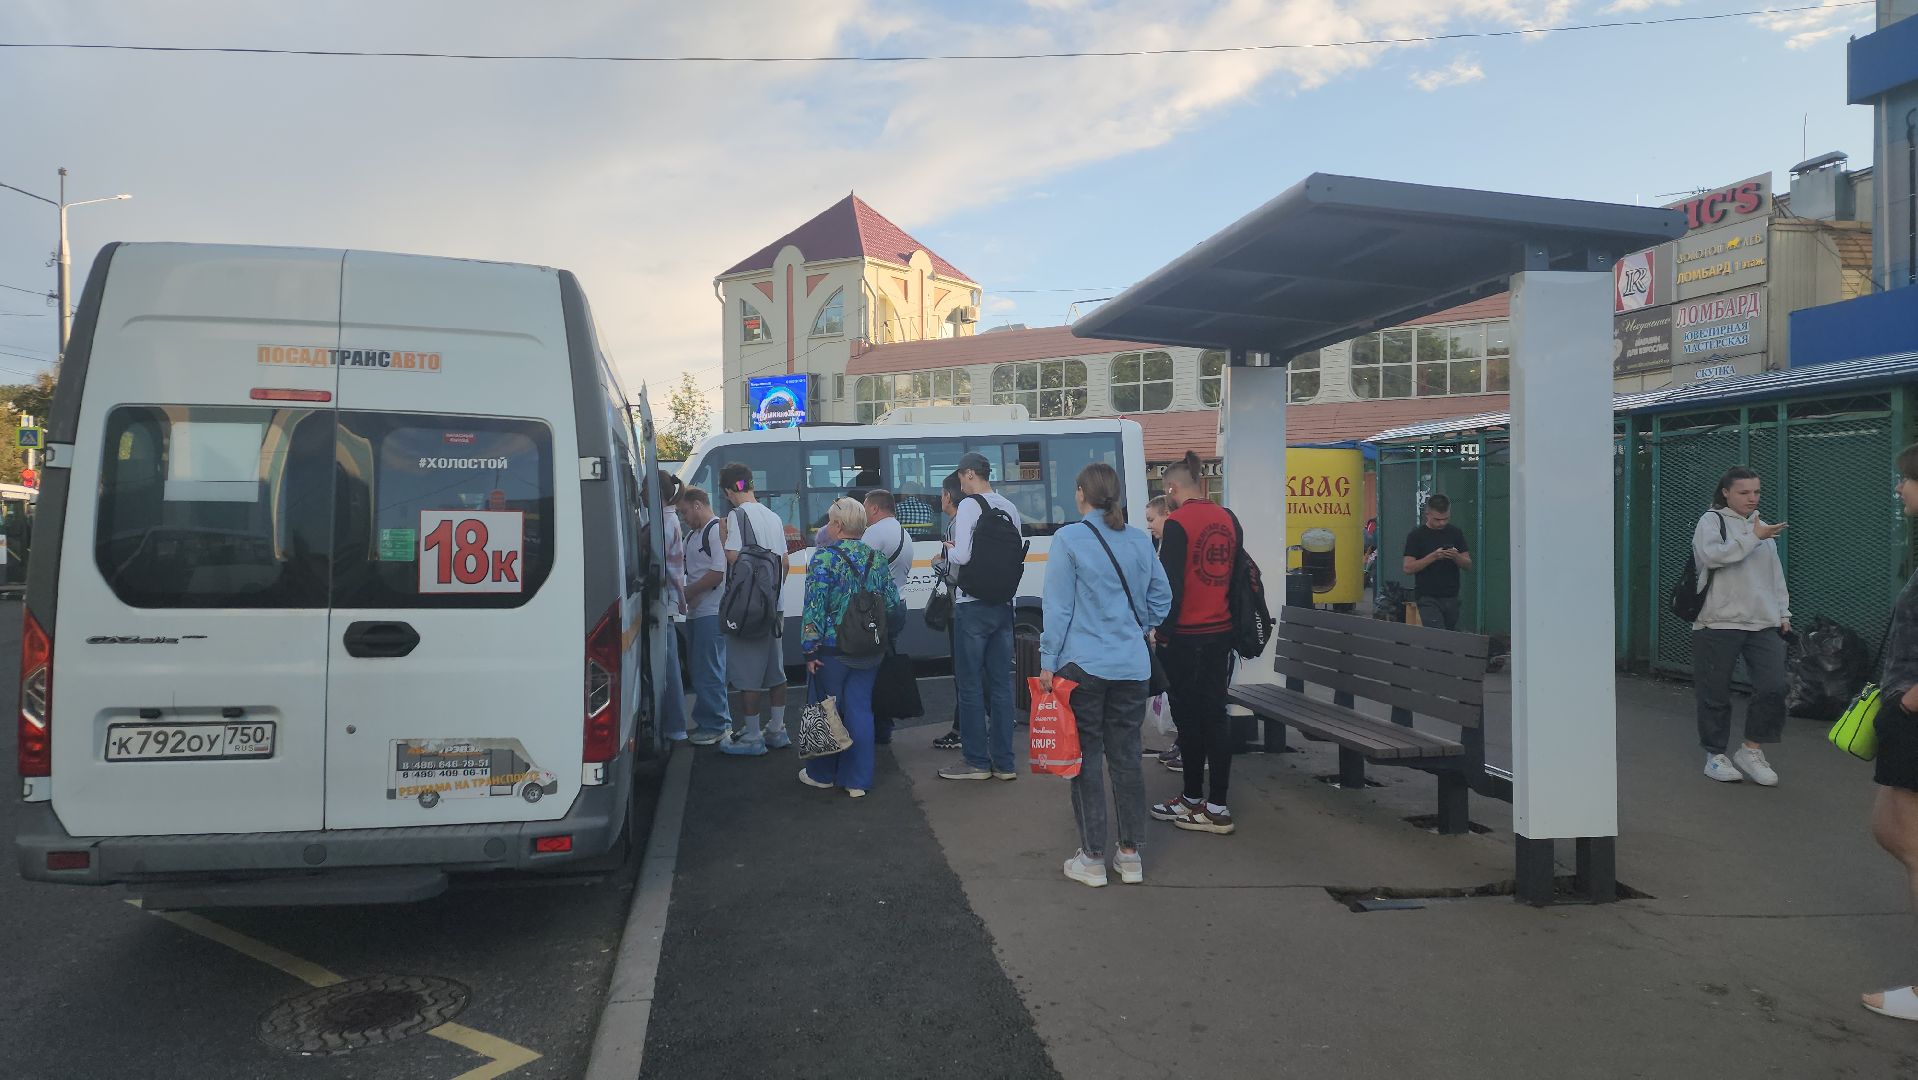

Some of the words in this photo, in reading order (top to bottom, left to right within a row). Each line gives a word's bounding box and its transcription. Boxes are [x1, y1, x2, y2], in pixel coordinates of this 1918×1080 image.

[1672, 182, 1762, 230] IC'S
[1676, 261, 1732, 285] ЛОМБАРД
[1676, 291, 1761, 328] ЛОМБАРД
[1683, 321, 1749, 342] ЮВЕЛИРНАЯ
[1682, 335, 1749, 354] МАСТЕРСКАЯ
[256, 346, 441, 370] ПОСАДТРАНСАВТО
[1695, 365, 1736, 380] СКУПКА
[418, 456, 508, 470] #ХОЛОСТОЙ
[1287, 502, 1351, 516] ИМОНАД
[226, 726, 266, 745] 750
[234, 744, 254, 752] RUS
[1031, 738, 1056, 750] KRUPS
[402, 762, 409, 770] 8
[402, 770, 409, 779] 8
[455, 779, 470, 791] НА
